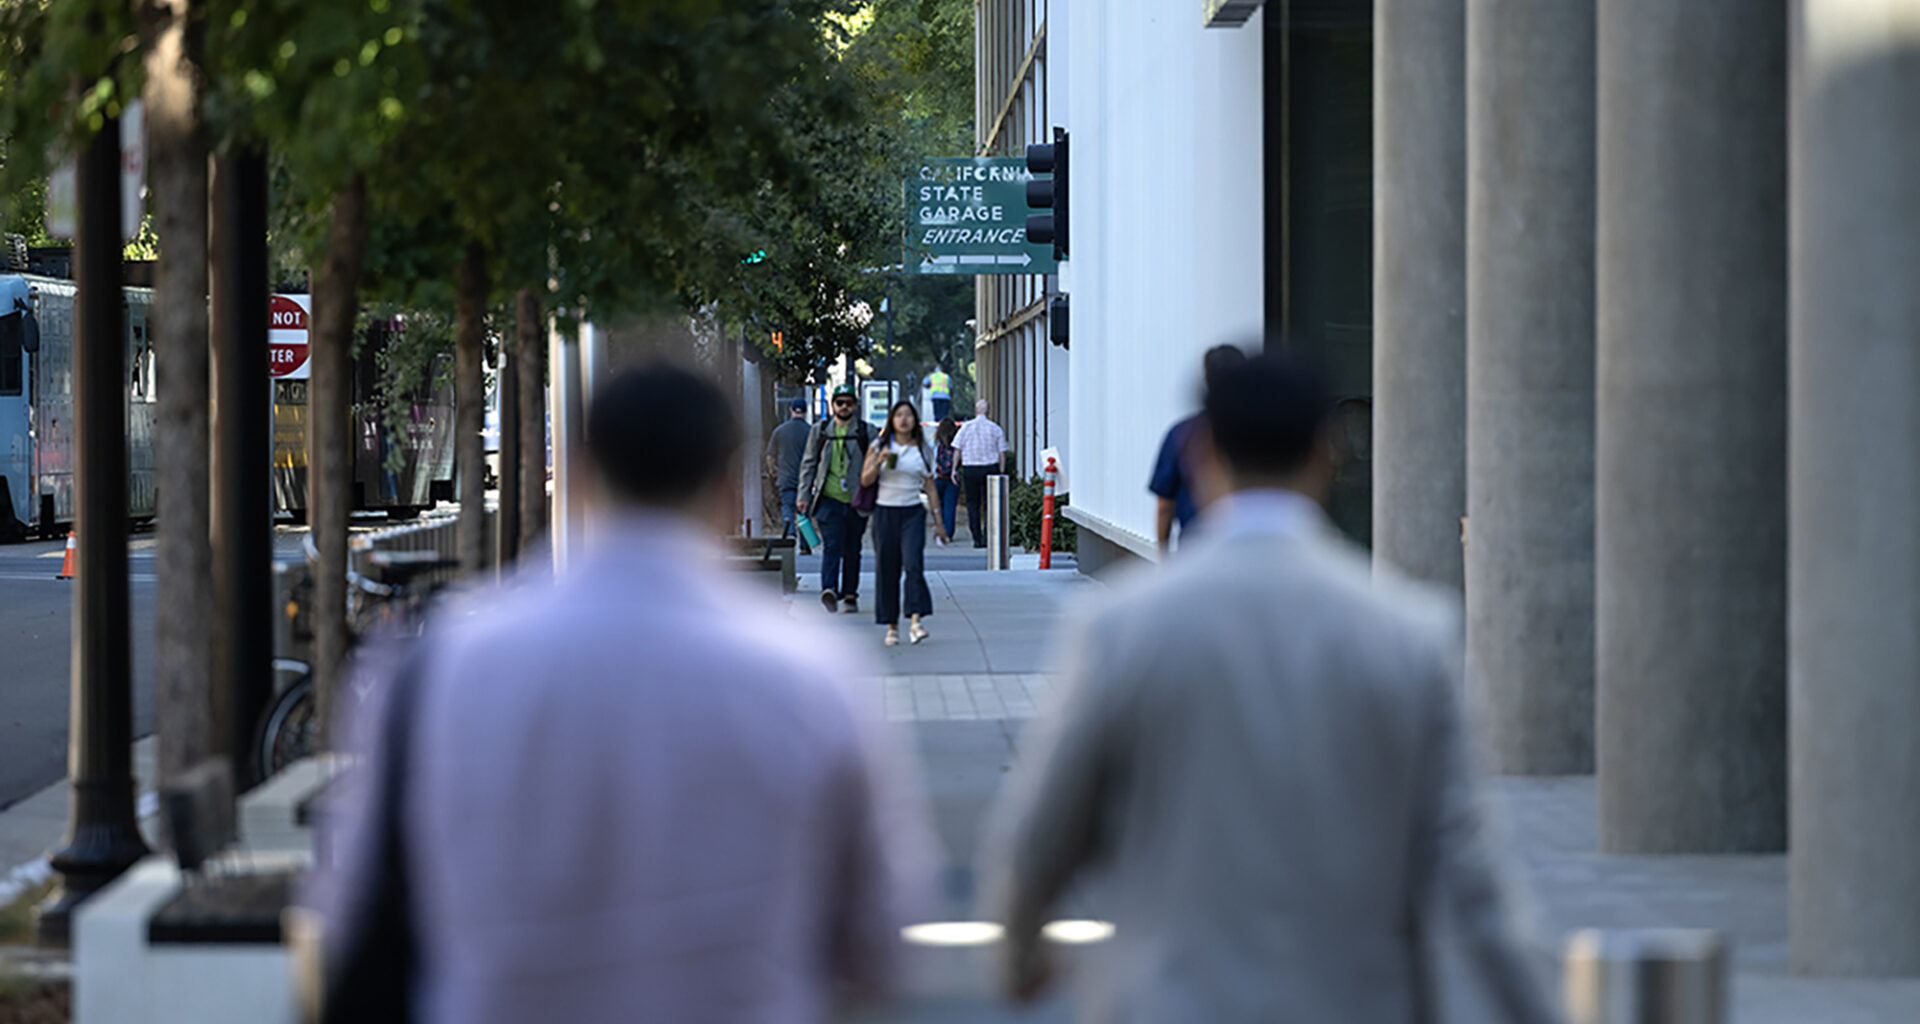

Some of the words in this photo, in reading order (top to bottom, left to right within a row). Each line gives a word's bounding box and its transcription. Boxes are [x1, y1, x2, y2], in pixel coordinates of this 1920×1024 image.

[920, 186, 983, 201] STATE
[920, 206, 1003, 221] GARAGE
[921, 228, 1026, 244] ENTRANCE
[273, 311, 301, 325] NOT
[270, 349, 294, 363] TER
